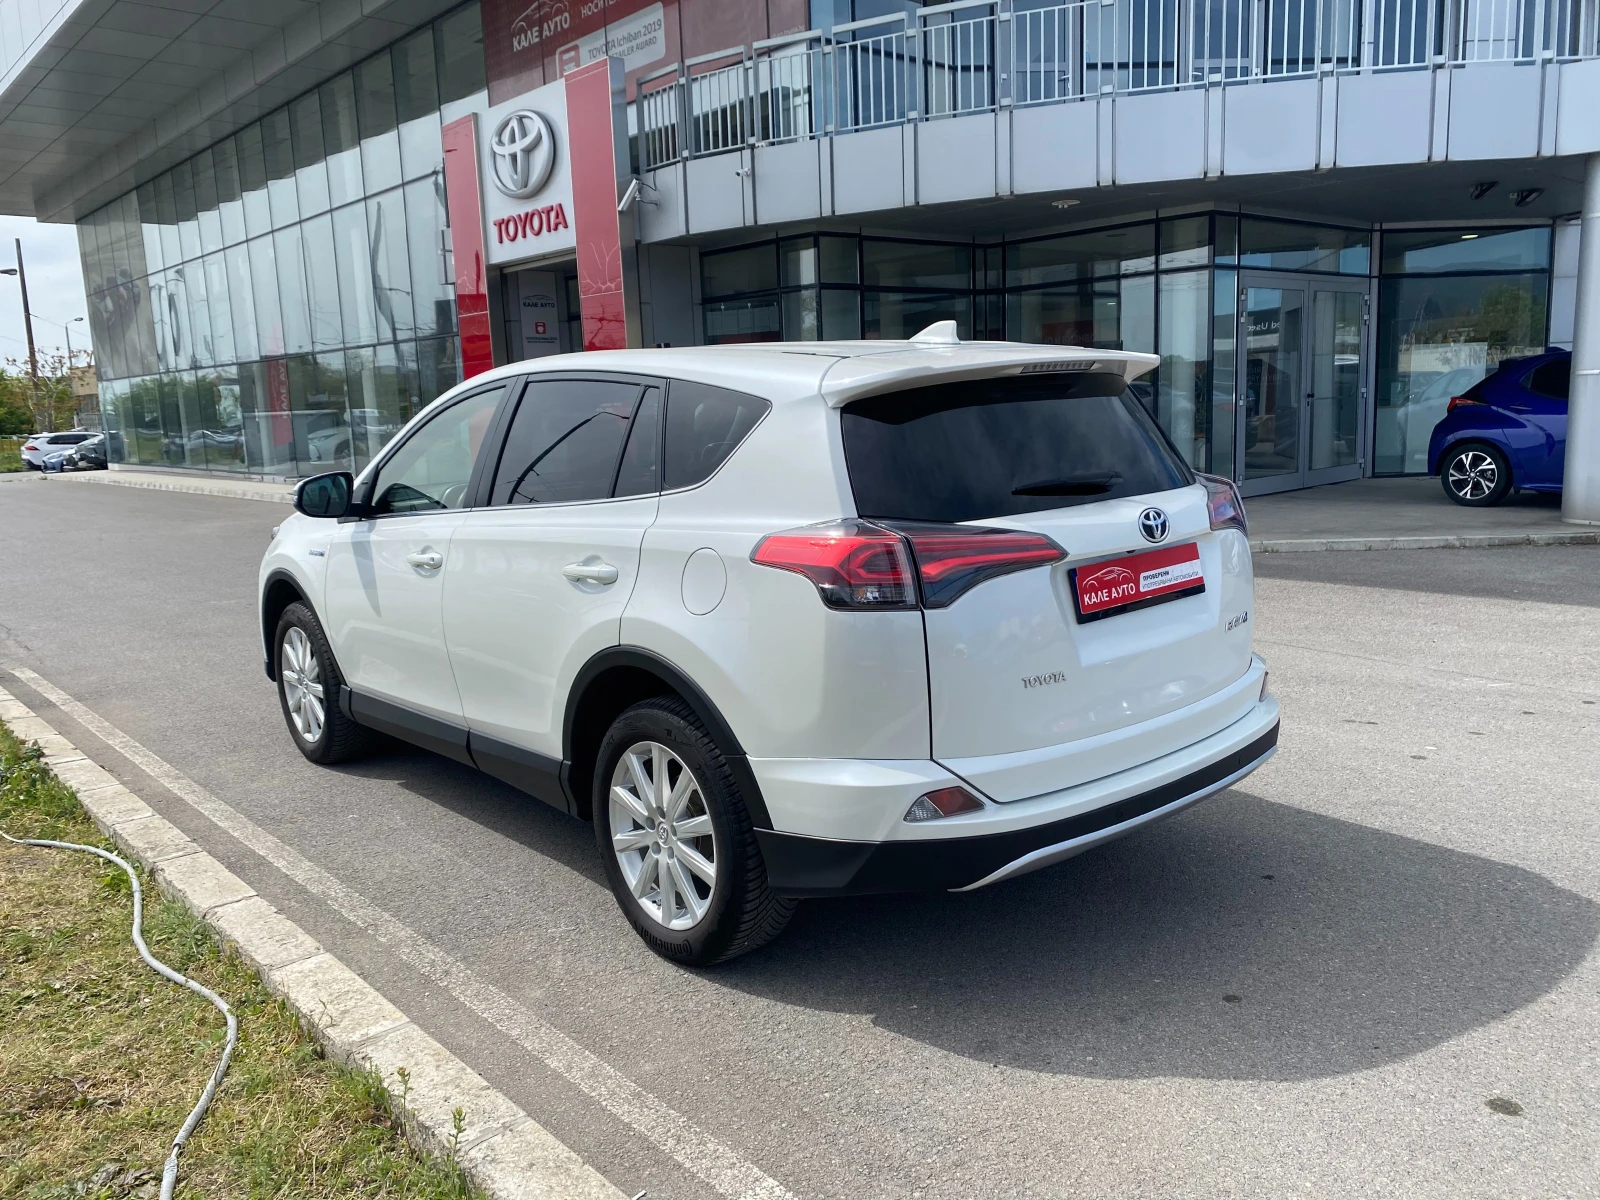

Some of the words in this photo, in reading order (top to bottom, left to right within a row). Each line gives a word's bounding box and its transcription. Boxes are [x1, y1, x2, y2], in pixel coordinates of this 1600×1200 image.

[513, 26, 540, 52] КАЛЕ
[543, 12, 570, 39] АУТО
[588, 39, 615, 59] TOYOTA
[616, 30, 642, 47] Ichiban
[643, 19, 662, 36] 2019
[612, 46, 635, 58] TAILER
[493, 203, 568, 244] TOYOTA
[1143, 570, 1170, 582] ПРОВЕРЕНИ
[1084, 589, 1110, 606] КАЛЕ
[1112, 583, 1136, 599] АУТО
[1021, 671, 1067, 688] TOYOTA
[640, 925, 693, 957] Continental
